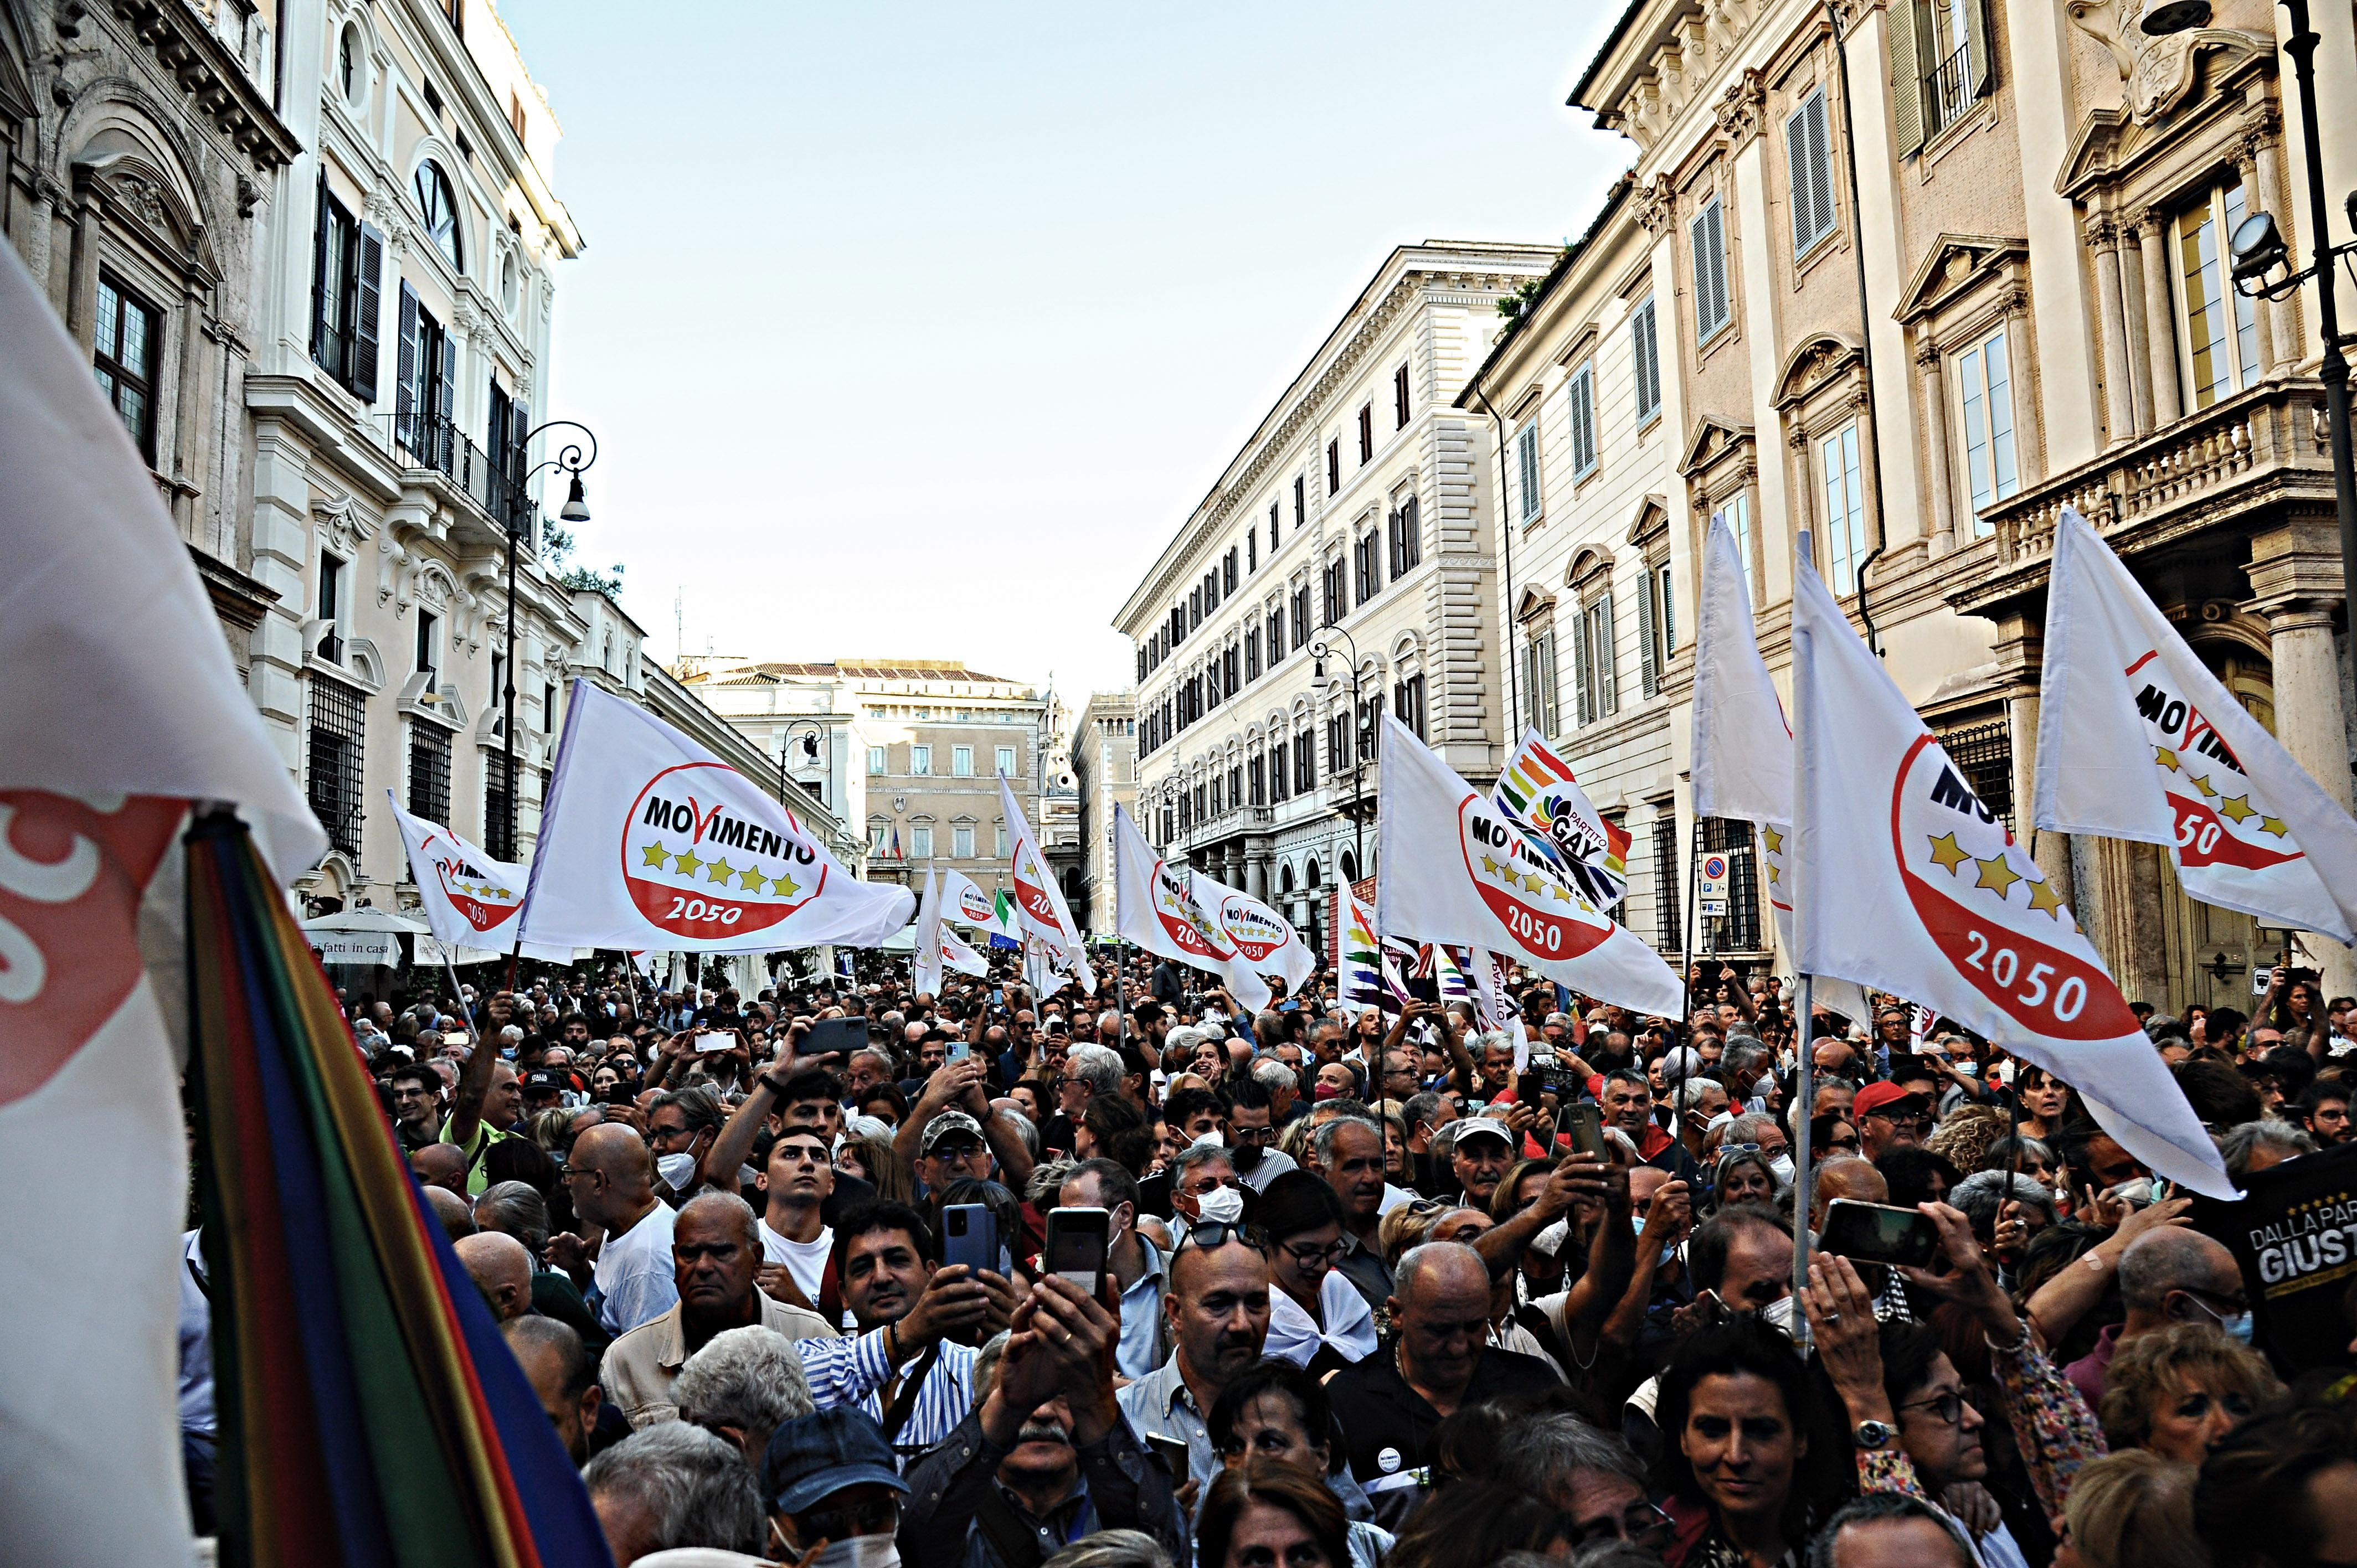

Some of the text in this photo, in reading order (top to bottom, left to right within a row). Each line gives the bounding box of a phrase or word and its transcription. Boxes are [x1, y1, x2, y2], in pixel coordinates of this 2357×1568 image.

[1552, 817, 1602, 860] GAY
[1569, 811, 1607, 847] PARTITO
[2170, 806, 2222, 855] 50
[467, 902, 487, 925] 2050
[665, 896, 742, 924] 2050
[969, 911, 984, 920] 2050
[1226, 907, 1283, 933] MOVIMENTO
[1508, 905, 1561, 952] 2050
[324, 942, 346, 952] fatti
[352, 943, 363, 953] in
[367, 944, 389, 953] casa
[1239, 943, 1264, 958] 2050
[1964, 930, 2087, 1022] 2050
[2250, 1213, 2319, 1250] DALLA
